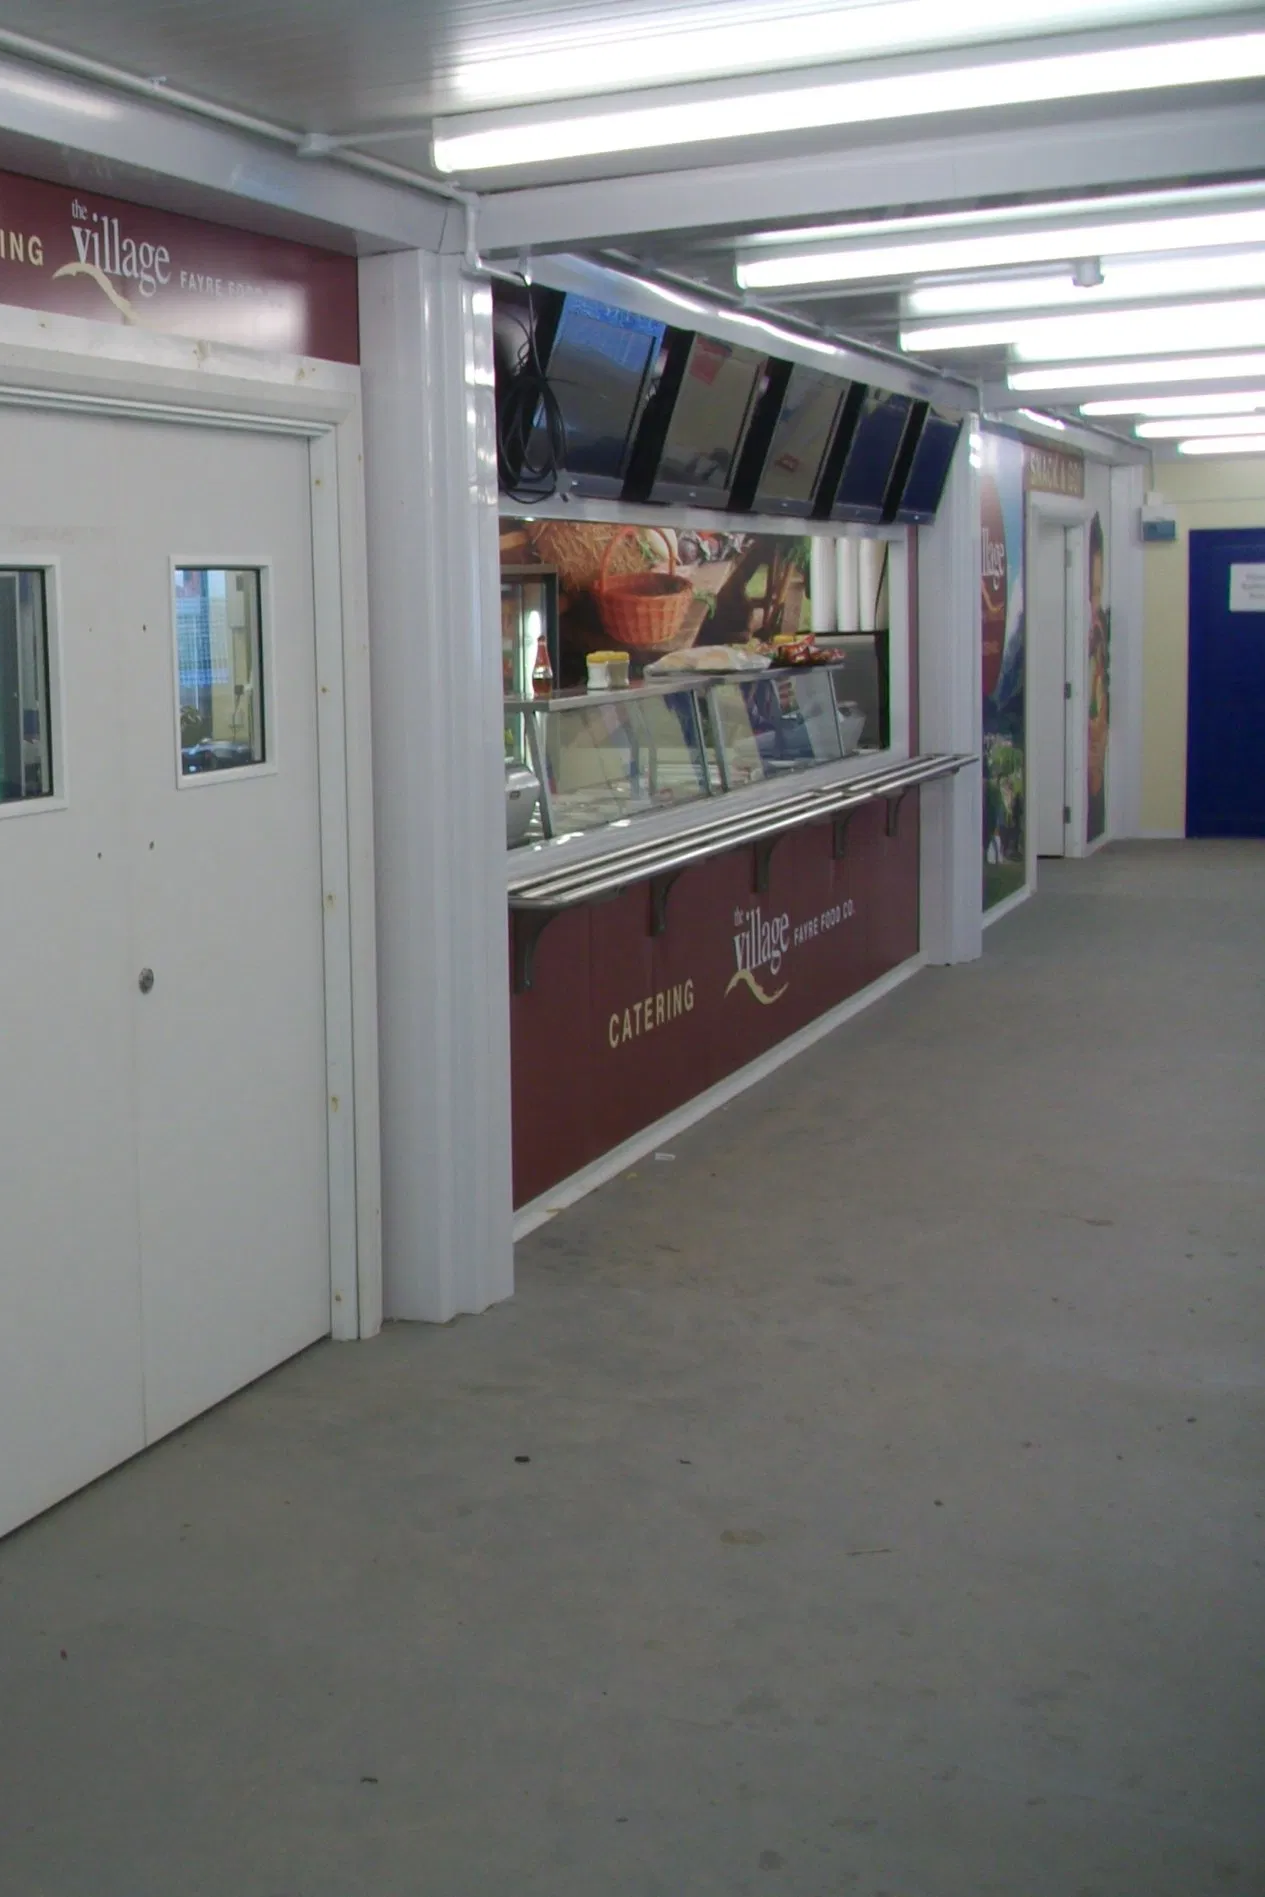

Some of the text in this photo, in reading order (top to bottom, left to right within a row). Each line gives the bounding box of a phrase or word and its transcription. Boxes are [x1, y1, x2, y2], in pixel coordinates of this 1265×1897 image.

[71, 198, 88, 221] the
[71, 211, 172, 298] village
[180, 270, 223, 298] FAYRE
[982, 526, 1005, 591] llage
[733, 906, 790, 976] village
[734, 905, 744, 927] the
[794, 916, 819, 946] FAYRE
[820, 905, 841, 933] FOOD
[609, 977, 695, 1049] CATERING
